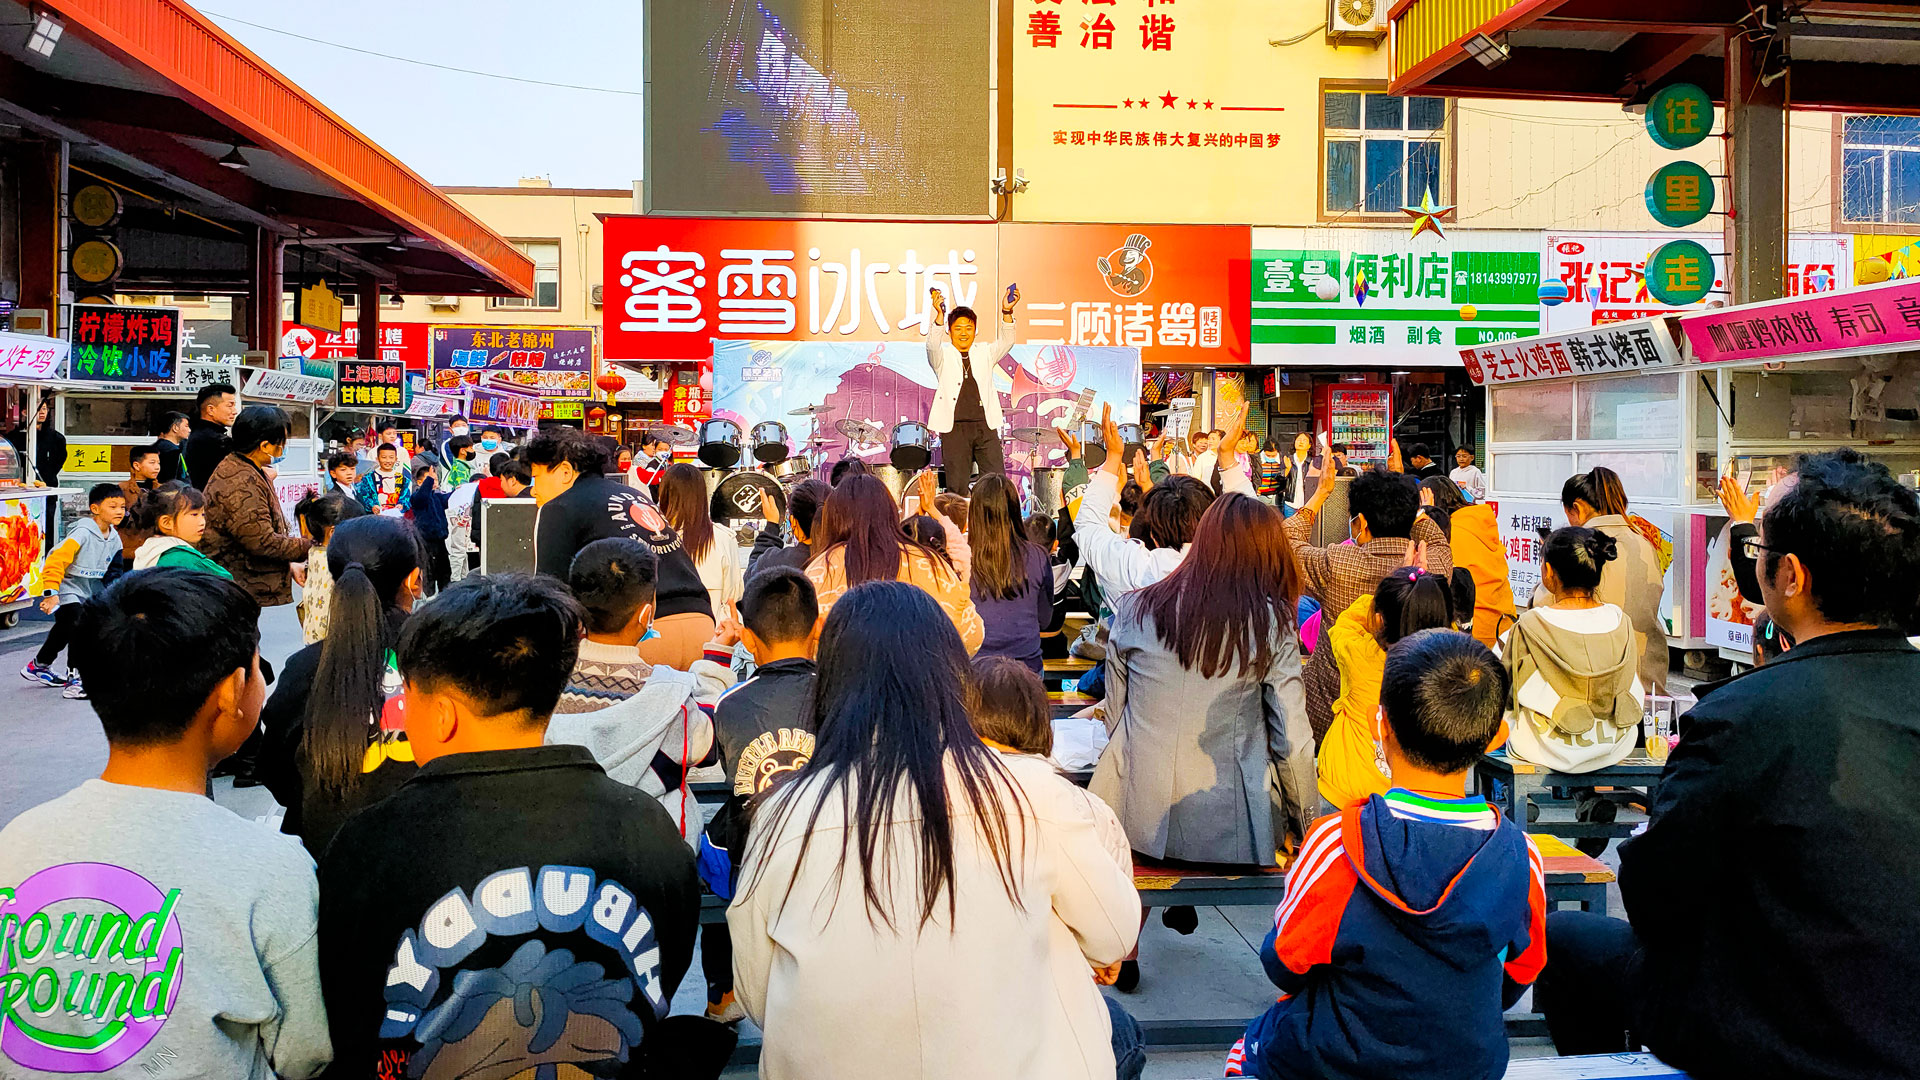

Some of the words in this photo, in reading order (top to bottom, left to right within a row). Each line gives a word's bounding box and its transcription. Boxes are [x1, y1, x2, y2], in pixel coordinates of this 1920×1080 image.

[1052, 130, 1282, 149] 实现中华民族伟大复兴的中国梦
[619, 244, 978, 336] 蜜雪冰城
[1344, 251, 1449, 299] 便利店
[1470, 272, 1538, 286] 18143997977
[79, 312, 172, 347] 柠檬炸鸡
[470, 330, 555, 350] 东北老锦州
[1026, 301, 1198, 348] 三顾诸葛
[1203, 310, 1219, 345] 烤串
[1349, 325, 1386, 345] 烟酒
[1407, 325, 1443, 345] 副食
[1706, 311, 1823, 353] 咖喱鸡肉饼
[1827, 302, 1887, 340] 寿司
[77, 344, 171, 378] 冷饮小吃
[450, 349, 488, 368] 海鲜
[1481, 341, 1574, 381] 芝士火鸡面
[1566, 328, 1663, 373] 韩式烤面
[340, 365, 401, 384] 上海鸡柳
[340, 385, 401, 405] 甘梅薯条
